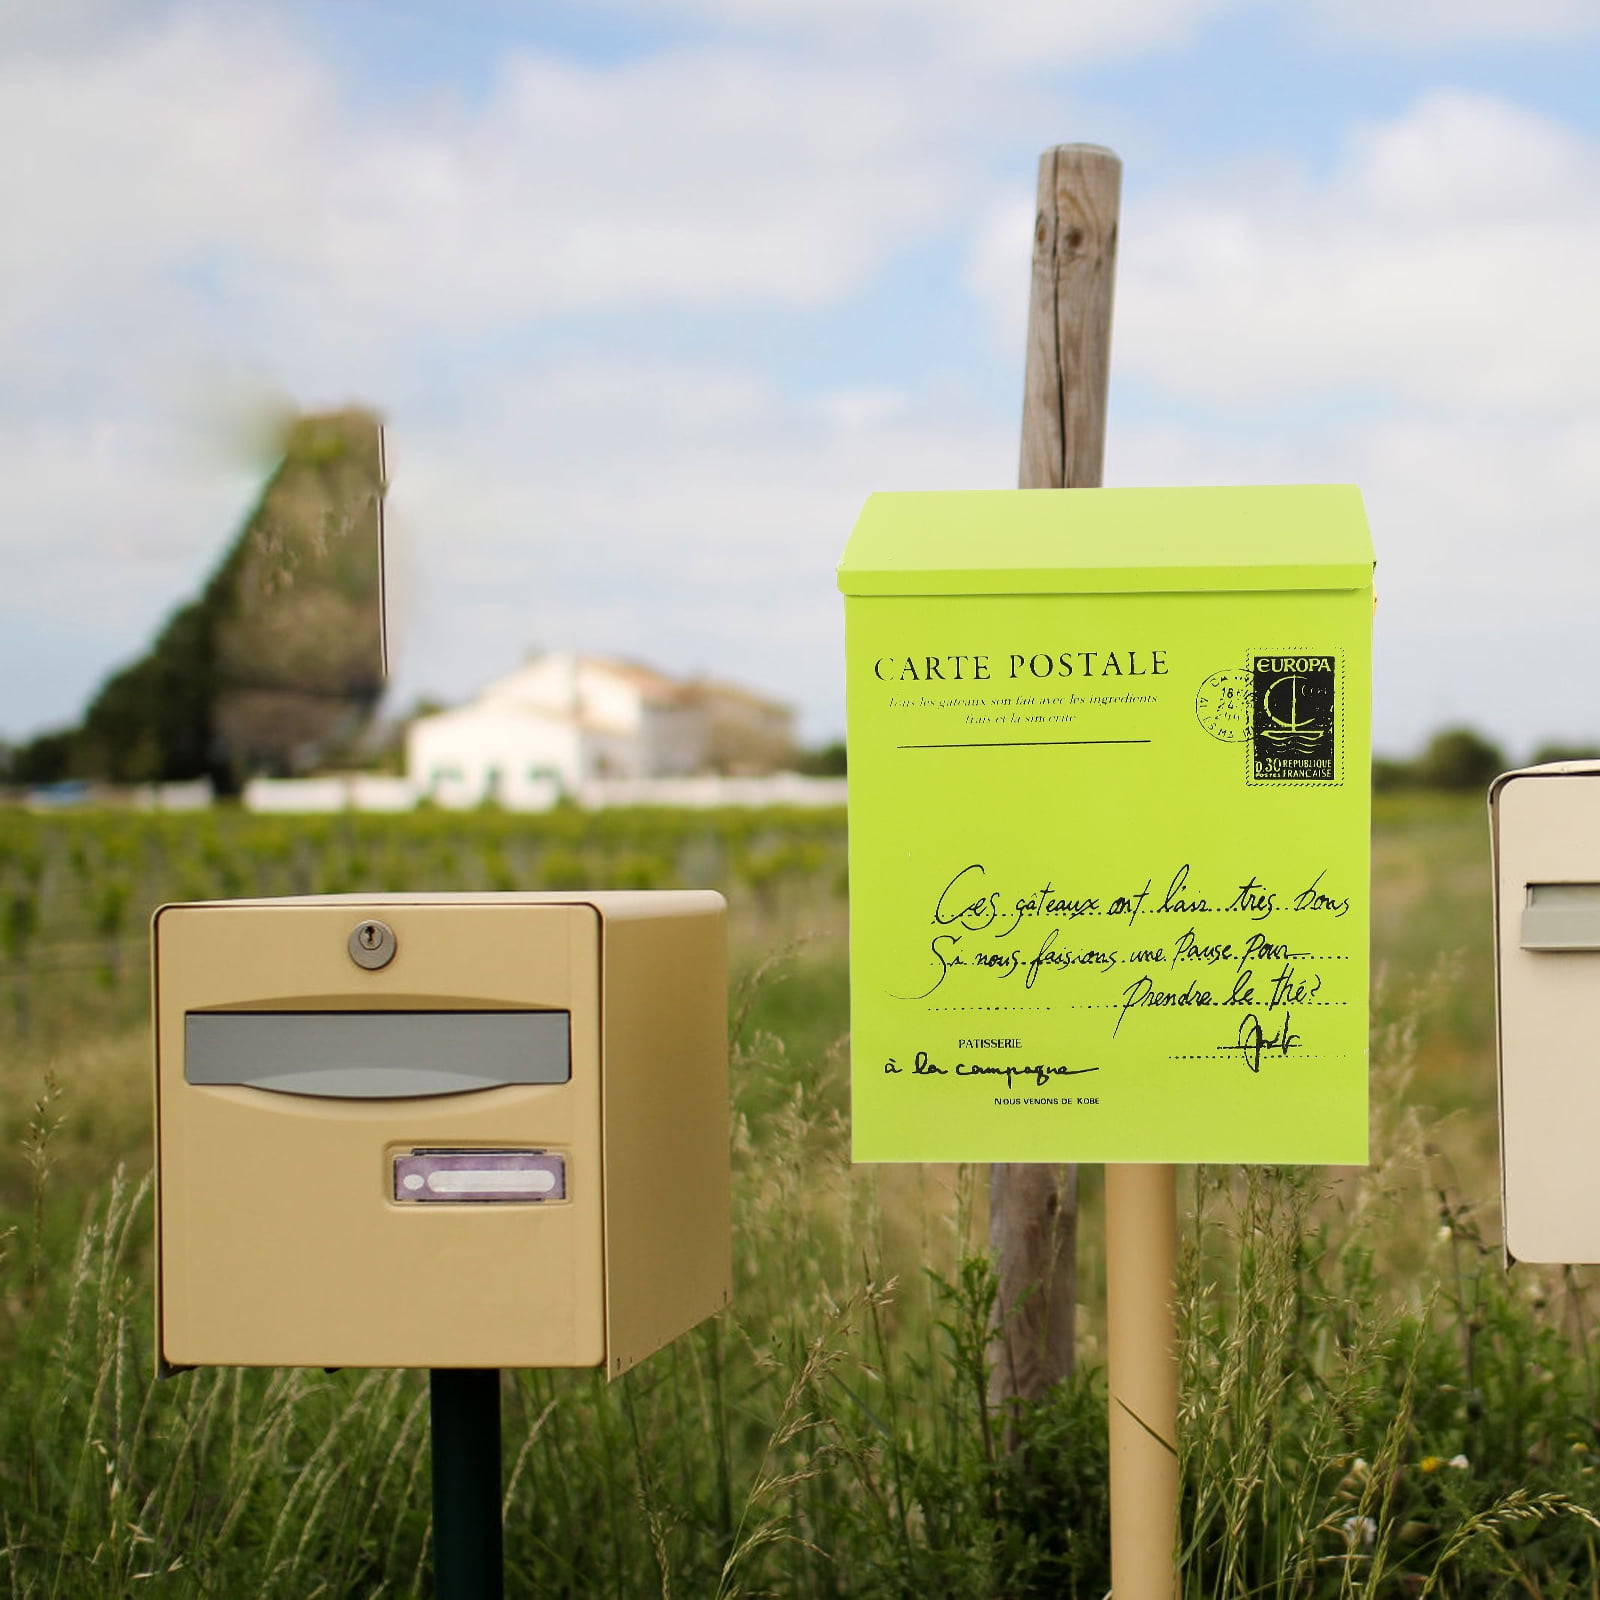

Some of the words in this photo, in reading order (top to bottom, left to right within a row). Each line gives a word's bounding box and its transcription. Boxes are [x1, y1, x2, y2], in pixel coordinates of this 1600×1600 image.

[874, 656, 991, 681] CARTE
[1009, 650, 1169, 678] POSTALE
[1256, 658, 1332, 673] EUROPA
[1069, 693, 1086, 704] les
[935, 864, 1001, 930] Ces
[995, 881, 1100, 937] gâteaux
[1107, 878, 1151, 927] ont
[884, 935, 963, 1000] Si
[974, 950, 1021, 978] nous
[1026, 929, 1118, 989] faisions
[1130, 948, 1166, 962] une
[1223, 969, 1255, 1004] le
[958, 1038, 1022, 1048] PATISSERIE
[912, 1051, 948, 1074] la
[955, 1063, 1099, 1089] campagne
[1023, 1097, 1059, 1105] VENONS
[1061, 1097, 1073, 1105] DE
